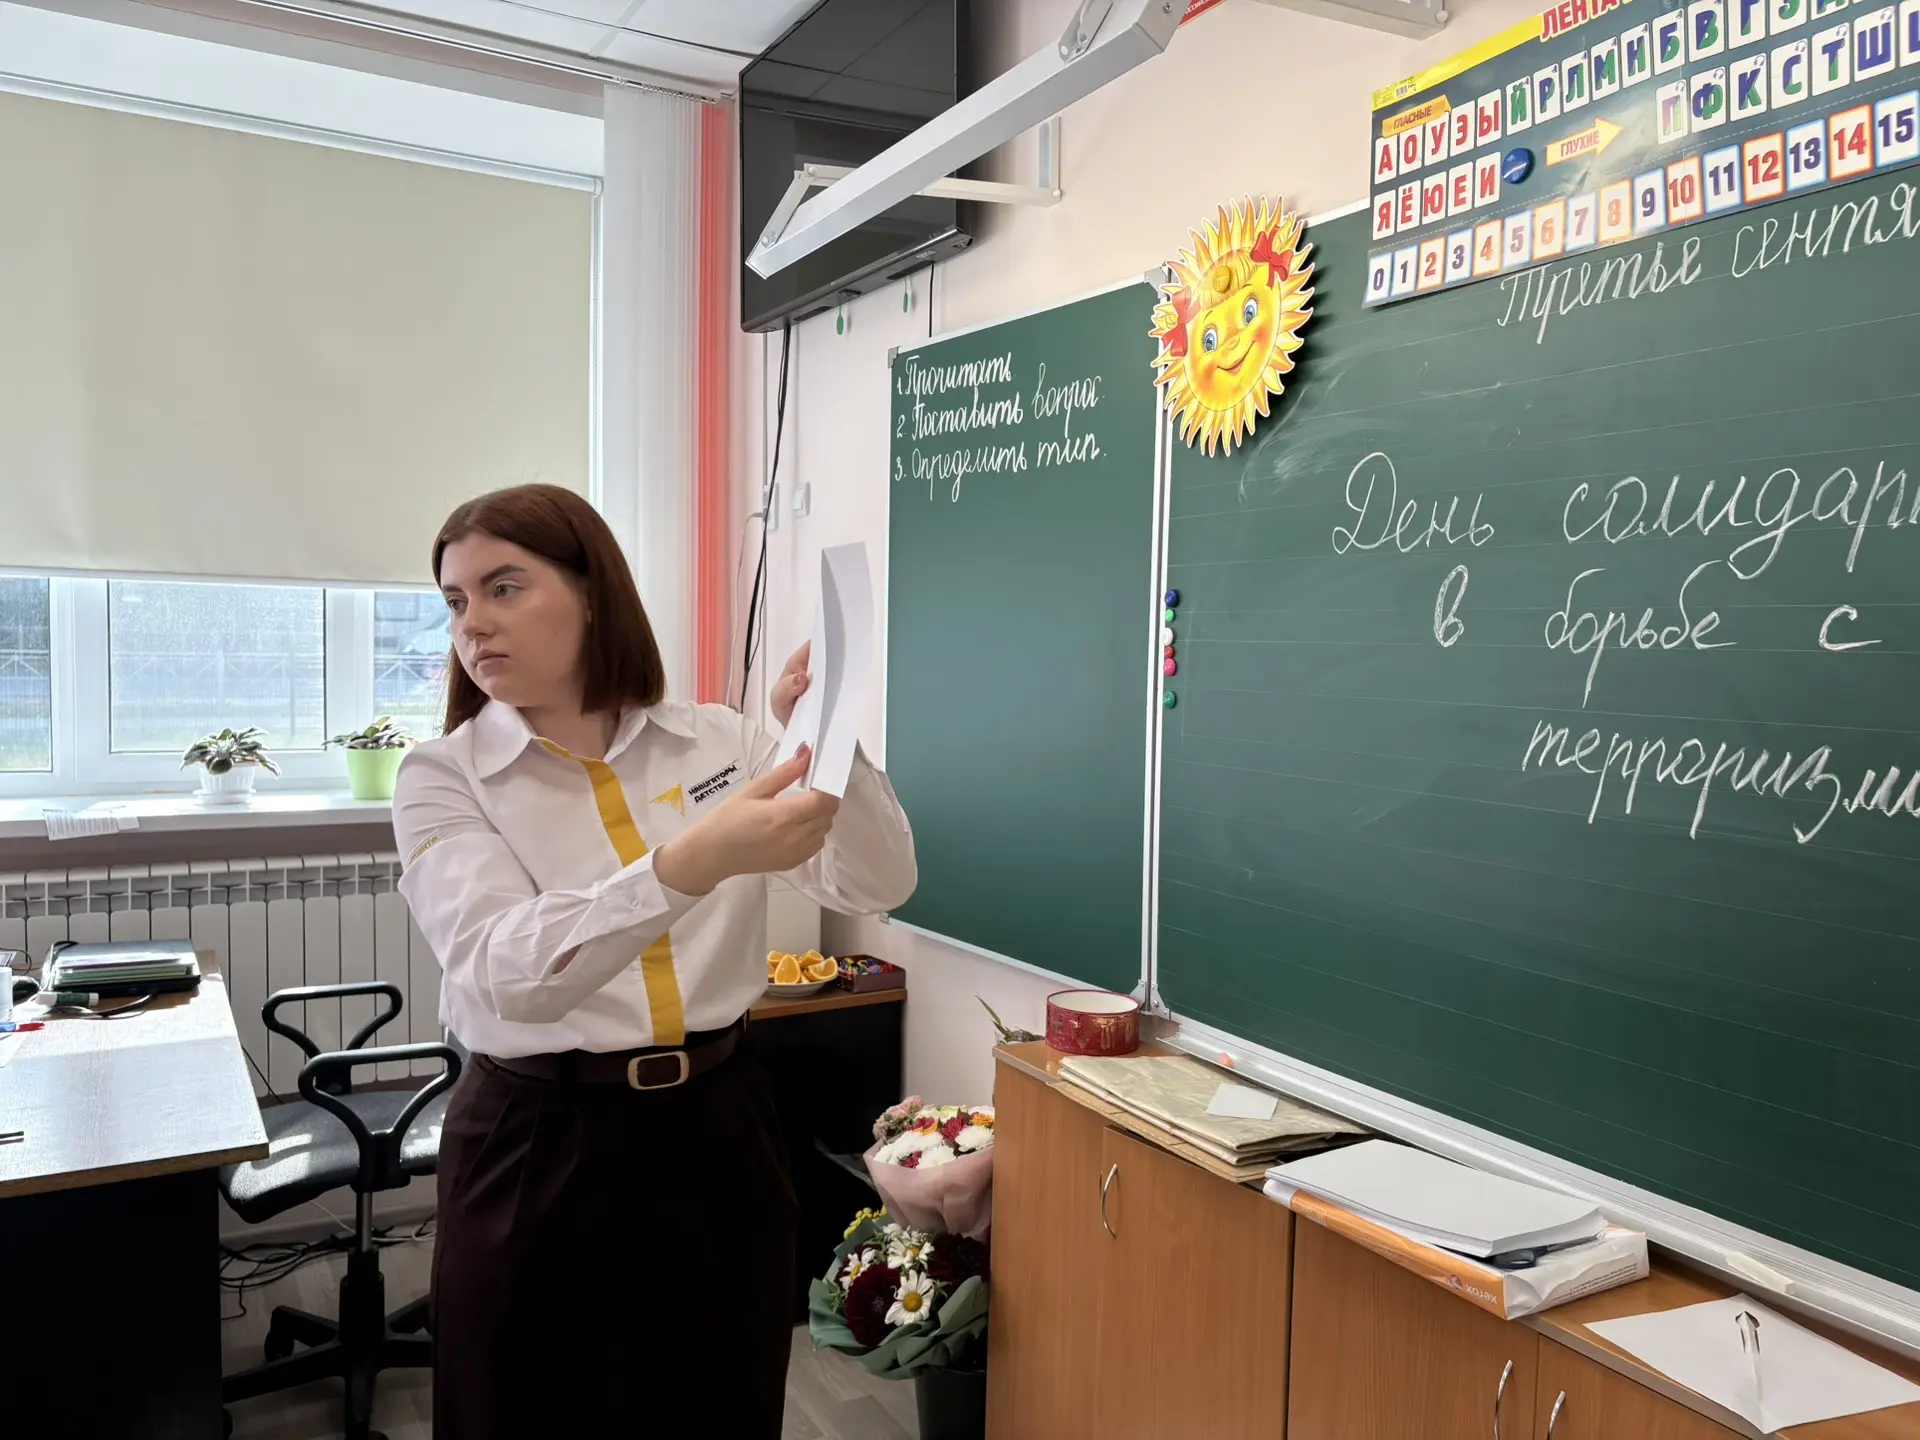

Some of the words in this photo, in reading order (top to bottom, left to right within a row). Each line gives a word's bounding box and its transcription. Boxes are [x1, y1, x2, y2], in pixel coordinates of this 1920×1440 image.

[1378, 144, 1394, 176] А
[1403, 134, 1418, 165] О
[1431, 122, 1446, 156] У
[1455, 114, 1469, 146] Э
[1478, 99, 1500, 138] Ы
[1510, 81, 1527, 126] Й
[1539, 77, 1556, 114] Р
[1565, 63, 1585, 104] Л
[1593, 48, 1616, 91] М
[1627, 35, 1646, 77] Н
[1659, 22, 1680, 64] Б
[1696, 9, 1719, 51] В
[1662, 94, 1682, 136] П
[1692, 82, 1724, 121] Ф
[1738, 68, 1762, 111] К
[1782, 54, 1803, 95] С
[1821, 37, 1847, 82] Т
[1857, 21, 1892, 72] Ш
[1392, 105, 1433, 130] ГЛАСНЫЕ
[1559, 130, 1600, 158] ГЛУХИЕ
[1373, 268, 1385, 291] 0
[1400, 260, 1408, 284] 1
[1424, 252, 1437, 277] 2
[1451, 244, 1465, 270] 3
[1480, 235, 1493, 261] 4
[1510, 225, 1525, 253] 5
[1541, 219, 1554, 245] 6
[1574, 206, 1590, 236] 7
[1607, 198, 1621, 227] 8
[1641, 187, 1655, 217] 9
[1668, 175, 1695, 207] 10
[1708, 161, 1735, 196] 11
[1748, 149, 1780, 185] 12
[1789, 136, 1821, 172] 13
[1833, 122, 1867, 160] 14
[1877, 105, 1915, 148] 15
[1376, 200, 1392, 232] Я
[1400, 187, 1413, 225] Ё
[1423, 183, 1444, 218] Ю
[1453, 174, 1467, 208] Е
[1479, 164, 1496, 199] И
[1497, 236, 1702, 345] Третье
[904, 351, 1012, 407] Прочитать
[911, 387, 1024, 441] Поставить
[912, 441, 1028, 503] Определить
[1332, 451, 1496, 555] День
[1544, 559, 1739, 708] борьбе
[1818, 603, 1883, 652] с
[687, 764, 738, 796] НАВИГАТОРЫ
[693, 780, 730, 804] ДЕТСТВА
[1465, 1283, 1498, 1305] xerox
